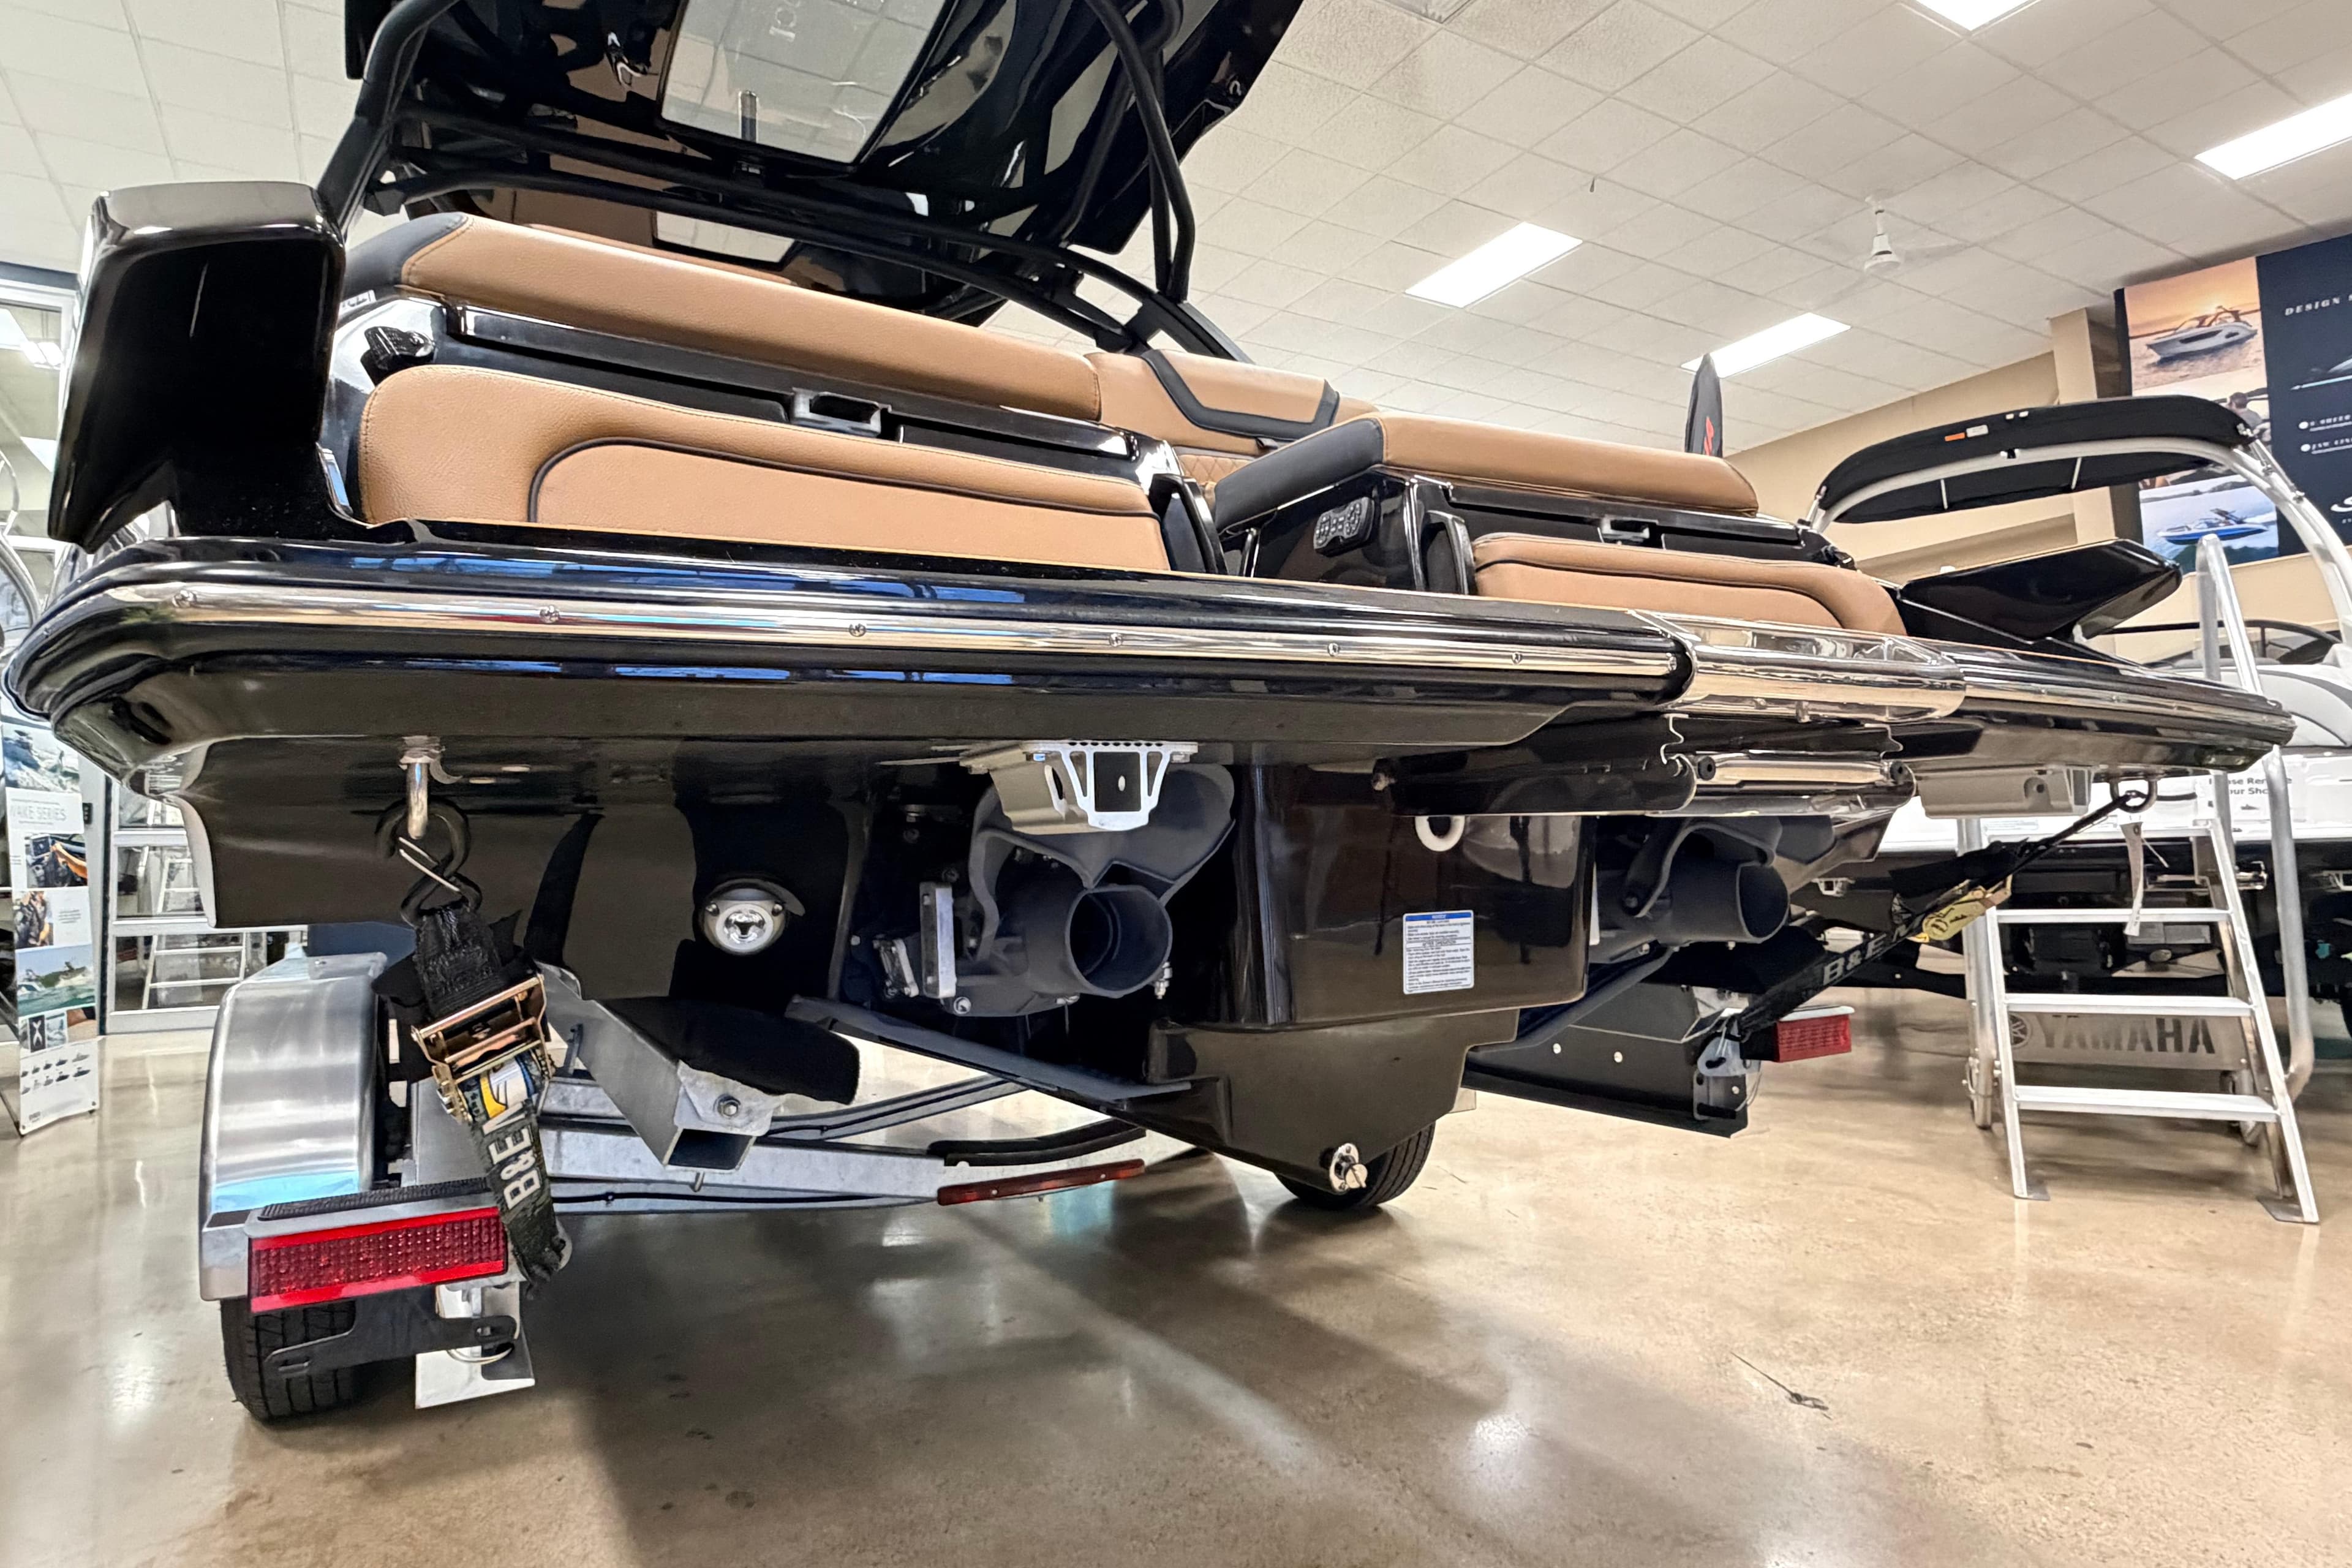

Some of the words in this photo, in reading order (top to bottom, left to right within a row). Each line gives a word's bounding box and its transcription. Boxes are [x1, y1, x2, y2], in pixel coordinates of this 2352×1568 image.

[2285, 297, 2340, 316] DESIGN
[1823, 933, 1887, 986] B&E
[2034, 1013, 2215, 1054] YAMAHA
[489, 1127, 540, 1210] B&E
